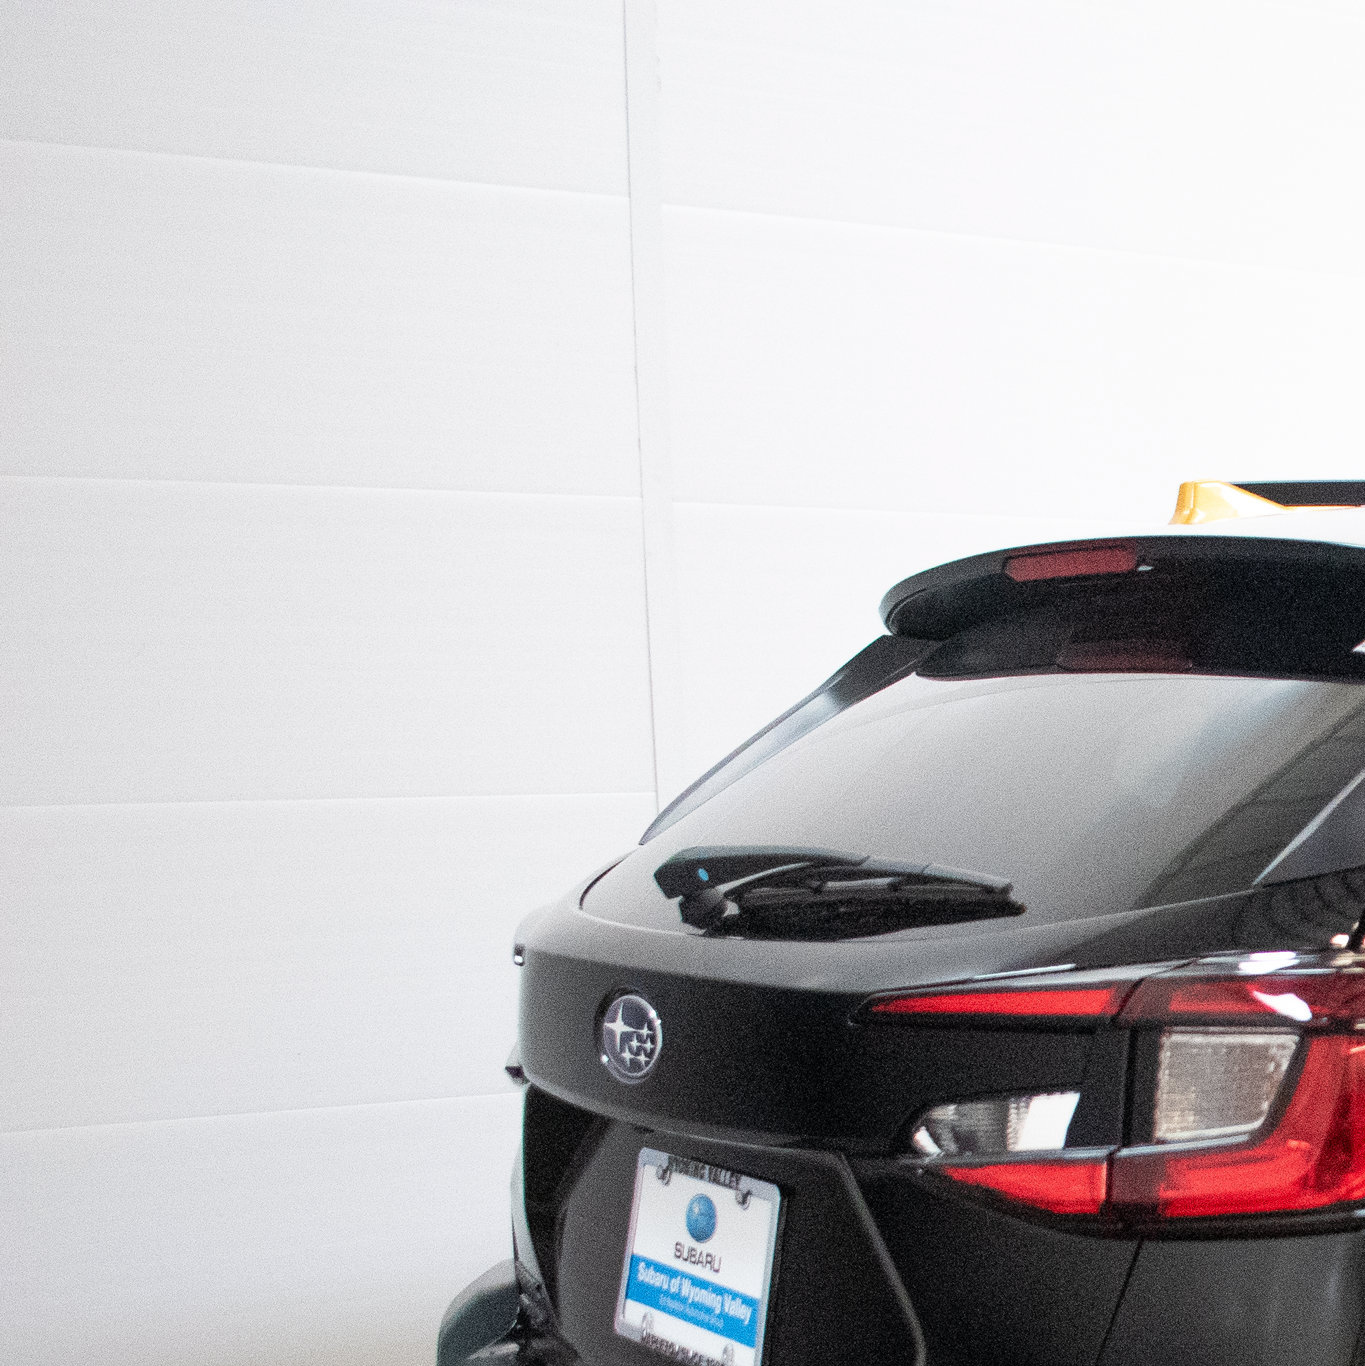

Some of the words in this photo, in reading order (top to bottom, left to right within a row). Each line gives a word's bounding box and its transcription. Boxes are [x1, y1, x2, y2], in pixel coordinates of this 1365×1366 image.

[674, 1241, 722, 1273] SUBARU
[637, 1261, 670, 1291] Subaru
[669, 1276, 681, 1294] of
[681, 1277, 722, 1315] Wyoming
[723, 1293, 752, 1325] Valley
